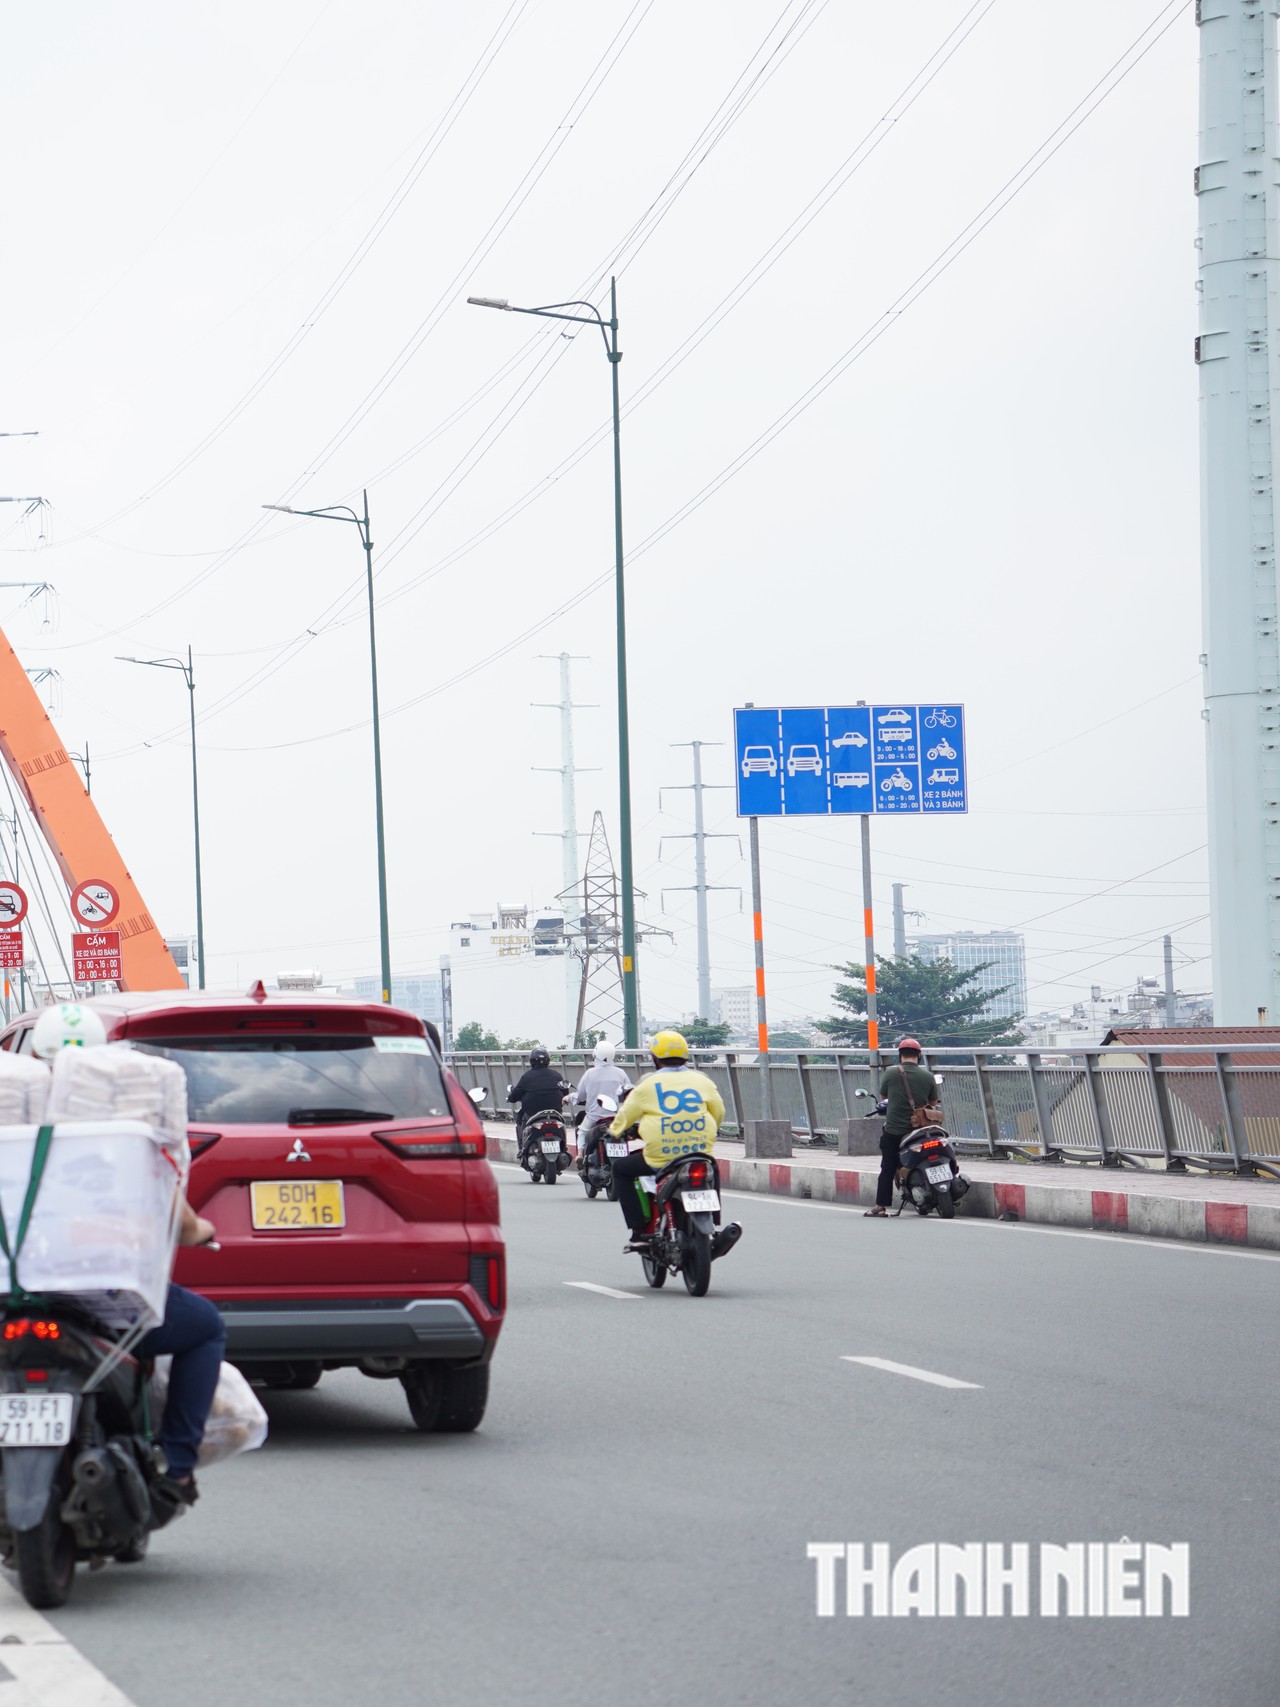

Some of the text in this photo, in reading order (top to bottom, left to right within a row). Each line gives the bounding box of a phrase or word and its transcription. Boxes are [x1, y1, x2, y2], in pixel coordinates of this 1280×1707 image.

[941, 788, 963, 798] BÁNH
[924, 799, 935, 808] VÀ
[942, 798, 964, 808] BÁNH
[655, 1082, 704, 1115] be
[661, 1115, 706, 1135] Food
[278, 1184, 317, 1203] 60H
[265, 1206, 334, 1225] 242.16
[8, 1399, 59, 1419] 59-F1
[0, 1422, 64, 1442] 711.18
